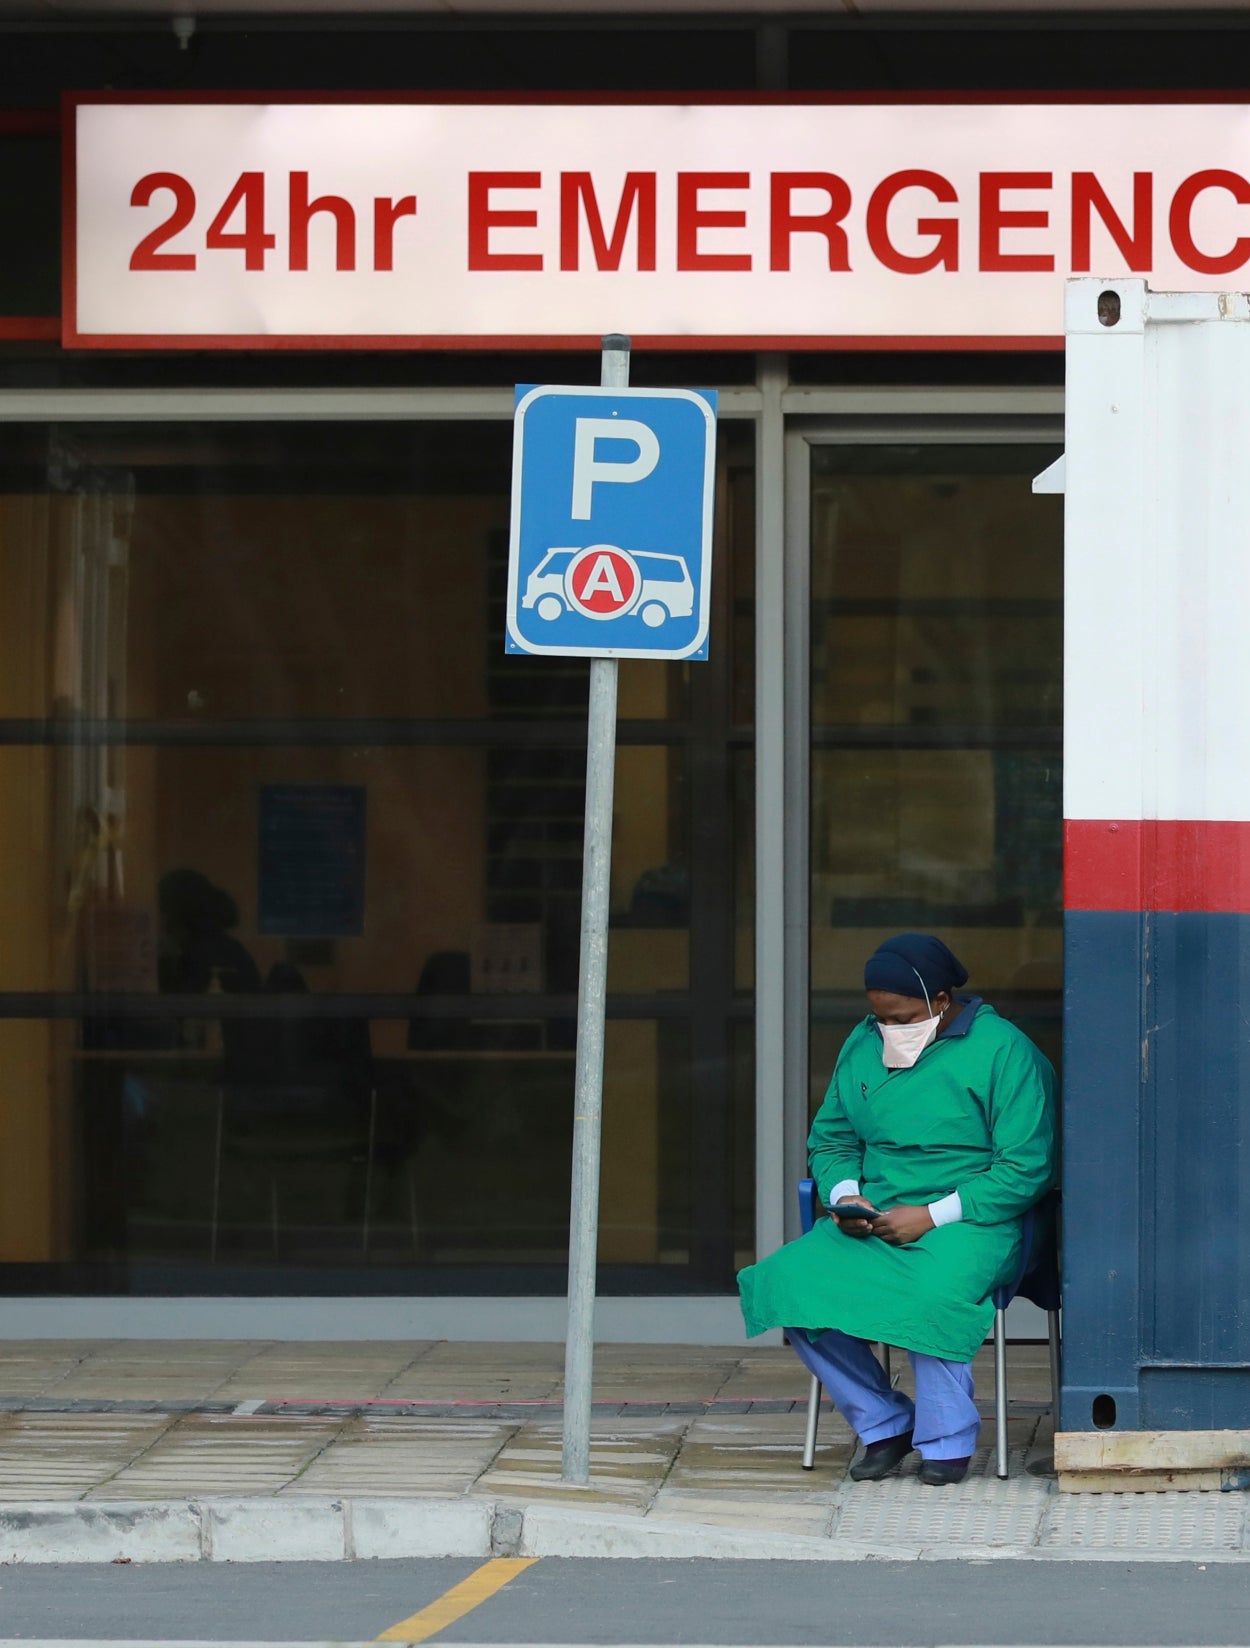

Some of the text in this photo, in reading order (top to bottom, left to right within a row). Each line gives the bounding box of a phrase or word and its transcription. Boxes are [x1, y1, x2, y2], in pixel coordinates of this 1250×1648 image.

[129, 171, 417, 272] 24hr
[571, 417, 660, 520] P
[579, 554, 625, 602] A
